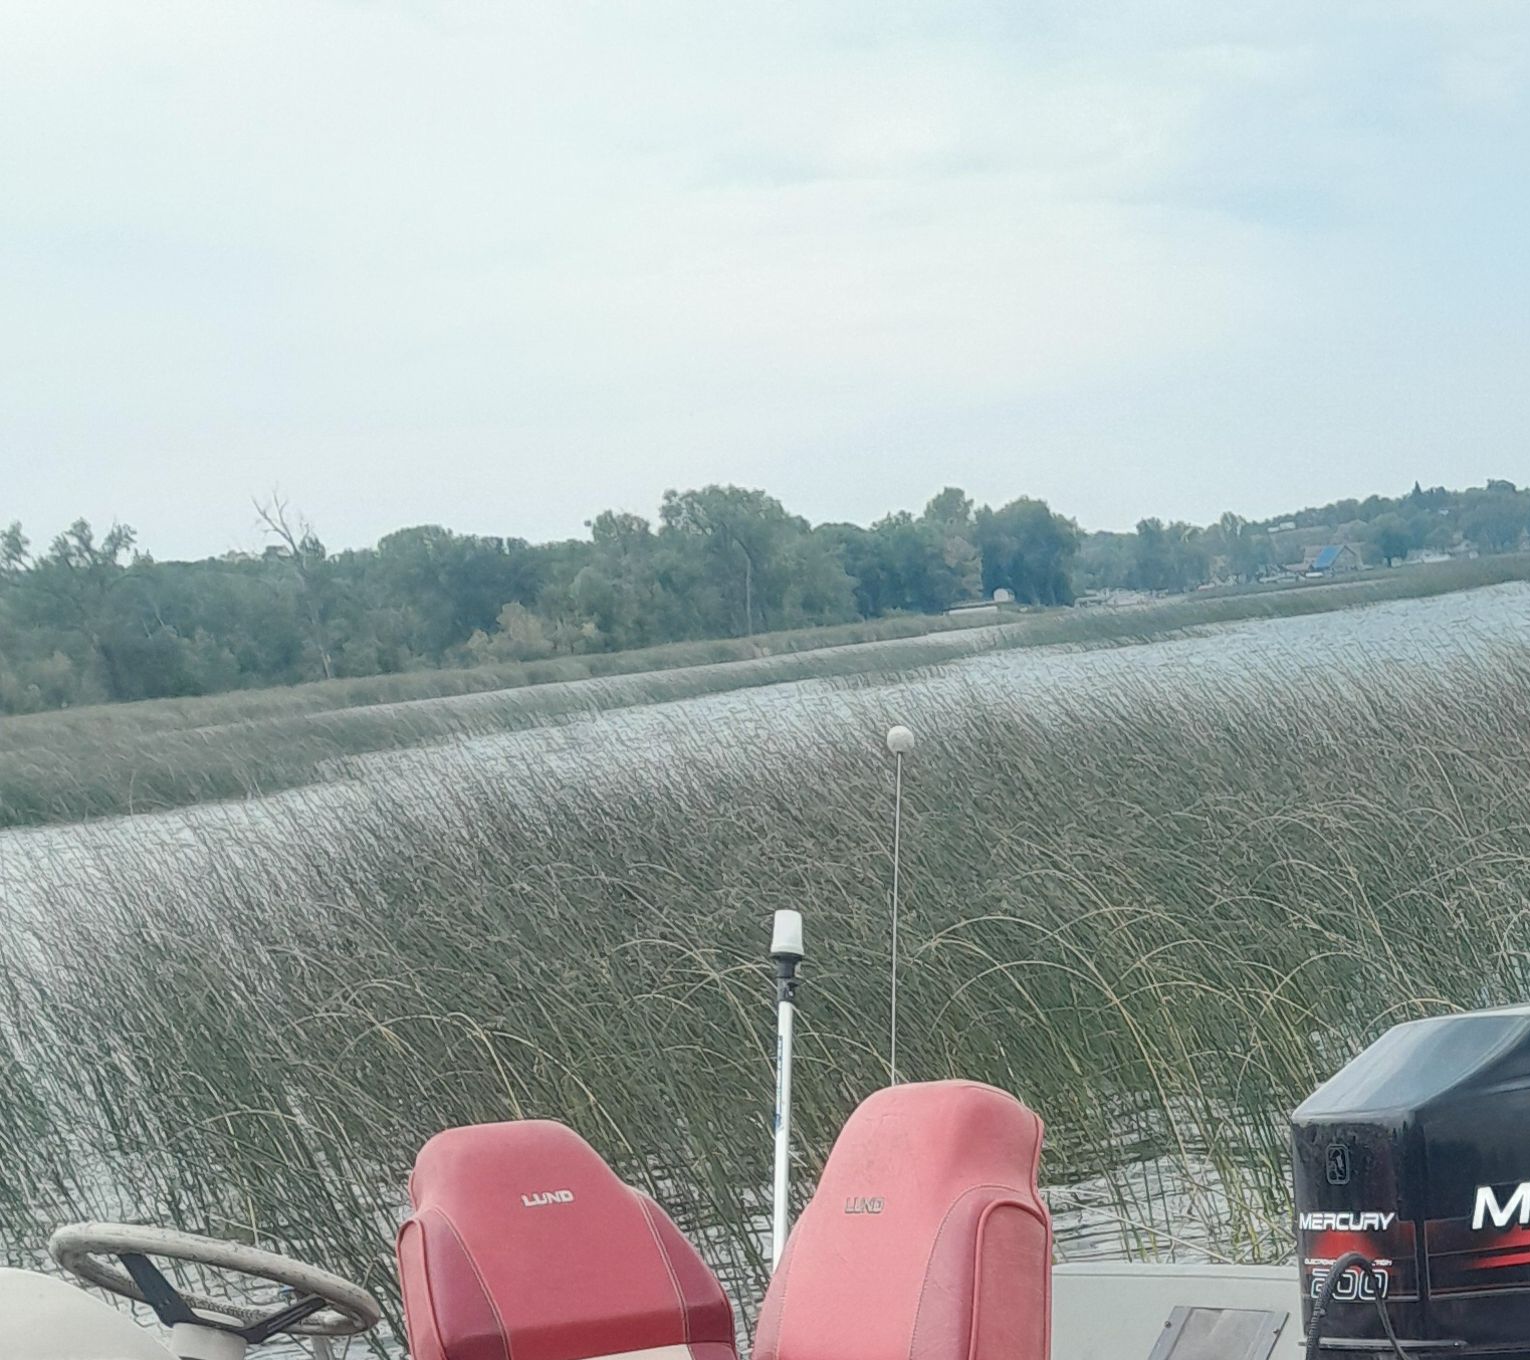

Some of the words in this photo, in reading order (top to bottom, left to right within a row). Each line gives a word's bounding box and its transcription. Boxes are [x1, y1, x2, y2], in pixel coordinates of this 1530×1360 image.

[519, 1188, 575, 1208] LUND
[844, 1196, 885, 1215] LUND
[1299, 1212, 1395, 1231] MERCURY
[1310, 1268, 1389, 1301] 200
